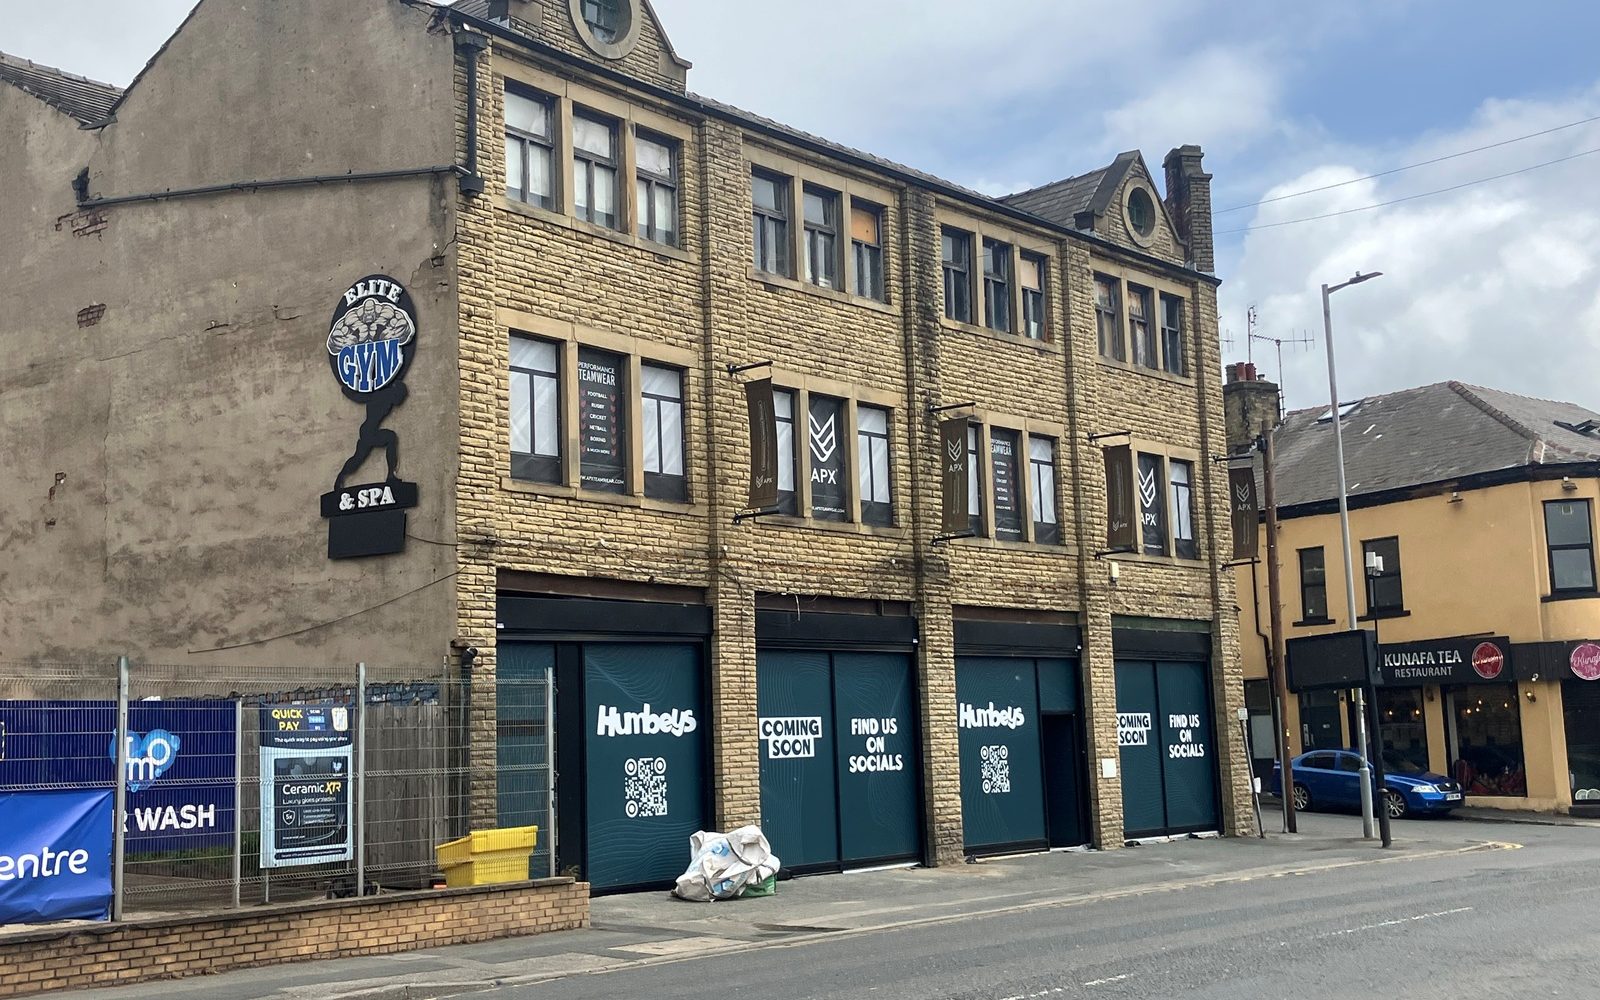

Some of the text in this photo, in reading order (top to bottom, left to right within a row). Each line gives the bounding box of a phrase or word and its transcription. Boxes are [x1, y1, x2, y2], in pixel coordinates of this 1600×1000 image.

[344, 280, 403, 306] ELITE
[338, 339, 403, 392] GYM
[578, 361, 615, 374] PERFORMANCE
[578, 369, 616, 386] TEAMWEAR
[587, 391, 607, 399] FOOTBALL
[590, 413, 607, 421] CRICKET
[589, 424, 607, 432] NETBALL
[948, 463, 963, 473] APX
[339, 486, 396, 511] & SPA
[1237, 503, 1252, 511] APX
[1384, 651, 1436, 667] KUNAFA
[1437, 650, 1463, 664] TEA
[1394, 666, 1453, 678] RESTAURANT
[271, 708, 303, 720] QUICK
[597, 703, 697, 737] Humbeys
[959, 702, 1025, 730] Humbeys
[1169, 714, 1200, 728] FIND US
[279, 721, 300, 731] PAY
[762, 719, 819, 736] COMING
[851, 718, 898, 735] FIND US
[1119, 730, 1145, 744] SOON
[1179, 729, 1192, 742] ON
[772, 739, 811, 756] SOON
[866, 737, 885, 753] ON
[1169, 744, 1205, 758] SOCIALS
[849, 754, 903, 773] SOCIALS
[134, 803, 215, 832] WASH
[0, 846, 89, 881] entre
